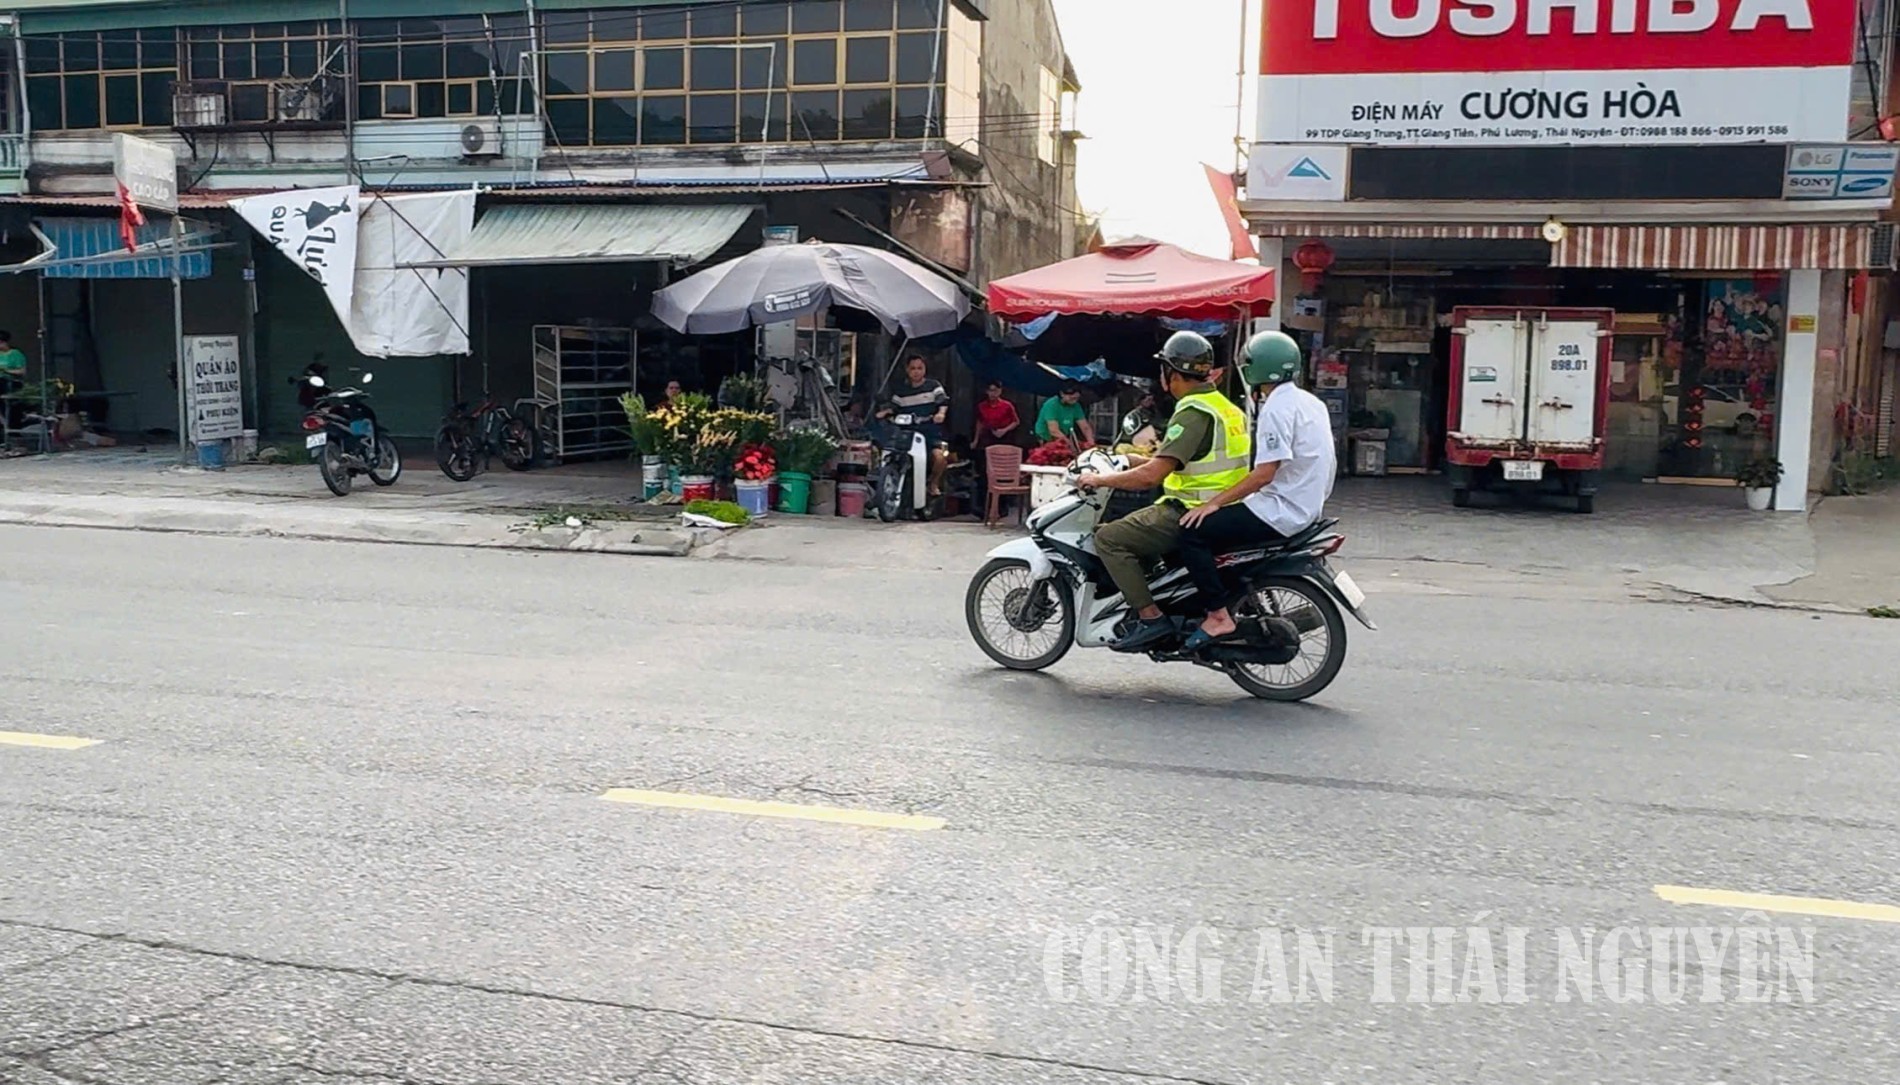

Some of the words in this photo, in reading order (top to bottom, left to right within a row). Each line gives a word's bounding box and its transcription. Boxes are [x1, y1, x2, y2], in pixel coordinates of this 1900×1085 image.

[1351, 101, 1396, 123] ĐIỆN
[1402, 100, 1443, 120] MÁY
[1460, 88, 1588, 119] CƯƠNG
[1603, 82, 1681, 118] HÒA
[1305, 128, 1319, 138] 99
[1815, 153, 1833, 165] LG
[1789, 178, 1834, 187] SONY
[1558, 344, 1580, 356] 20A
[1551, 359, 1588, 371] 898.01
